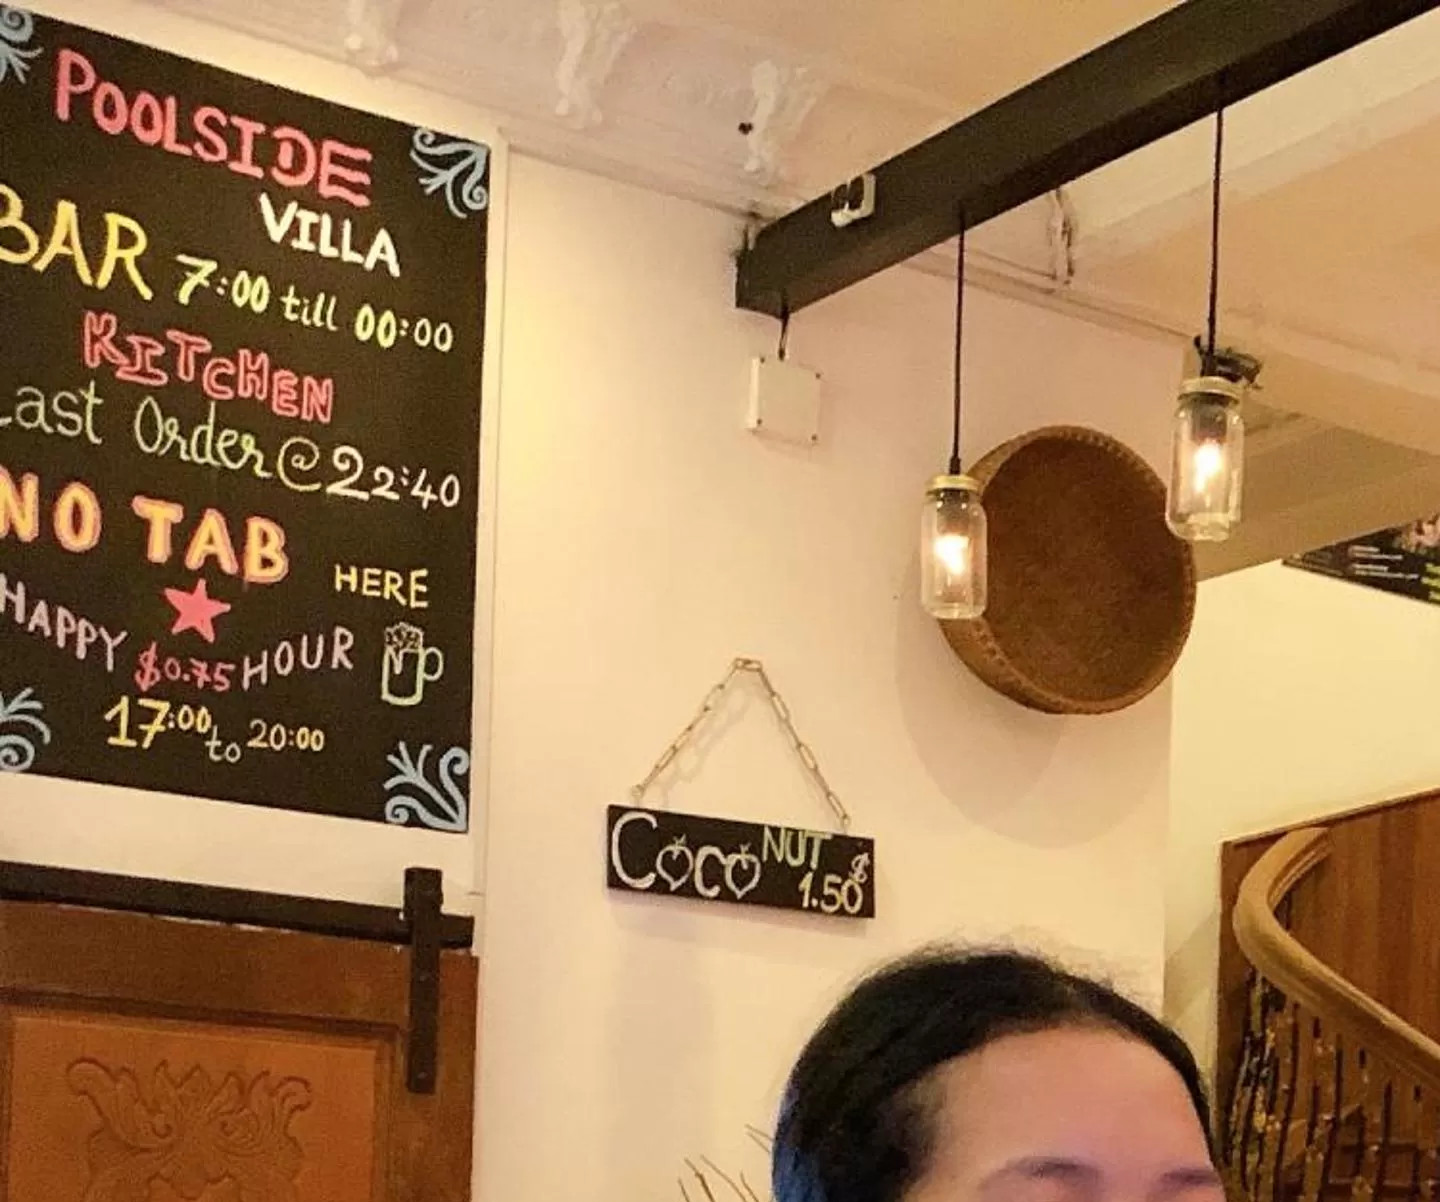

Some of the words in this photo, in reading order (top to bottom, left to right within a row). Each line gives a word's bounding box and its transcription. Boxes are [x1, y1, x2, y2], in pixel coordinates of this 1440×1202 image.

[55, 48, 373, 207] POOLSIDE
[0, 184, 154, 301] BAR
[175, 253, 271, 314] 7:00
[281, 283, 339, 331] till
[353, 304, 454, 353] 00:00
[259, 192, 401, 278] VILLA
[0, 380, 104, 444] ast
[82, 308, 335, 424] KITCHEN
[0, 464, 102, 553] NO
[131, 494, 290, 585] TAB
[334, 563, 430, 609] HERE
[0, 572, 128, 673] HAPPY
[241, 626, 355, 691] HOUR
[134, 641, 236, 692] $0.75
[104, 695, 213, 750] 17:00
[204, 724, 242, 763] to
[247, 718, 325, 752] 20:00
[762, 824, 832, 870] NUT
